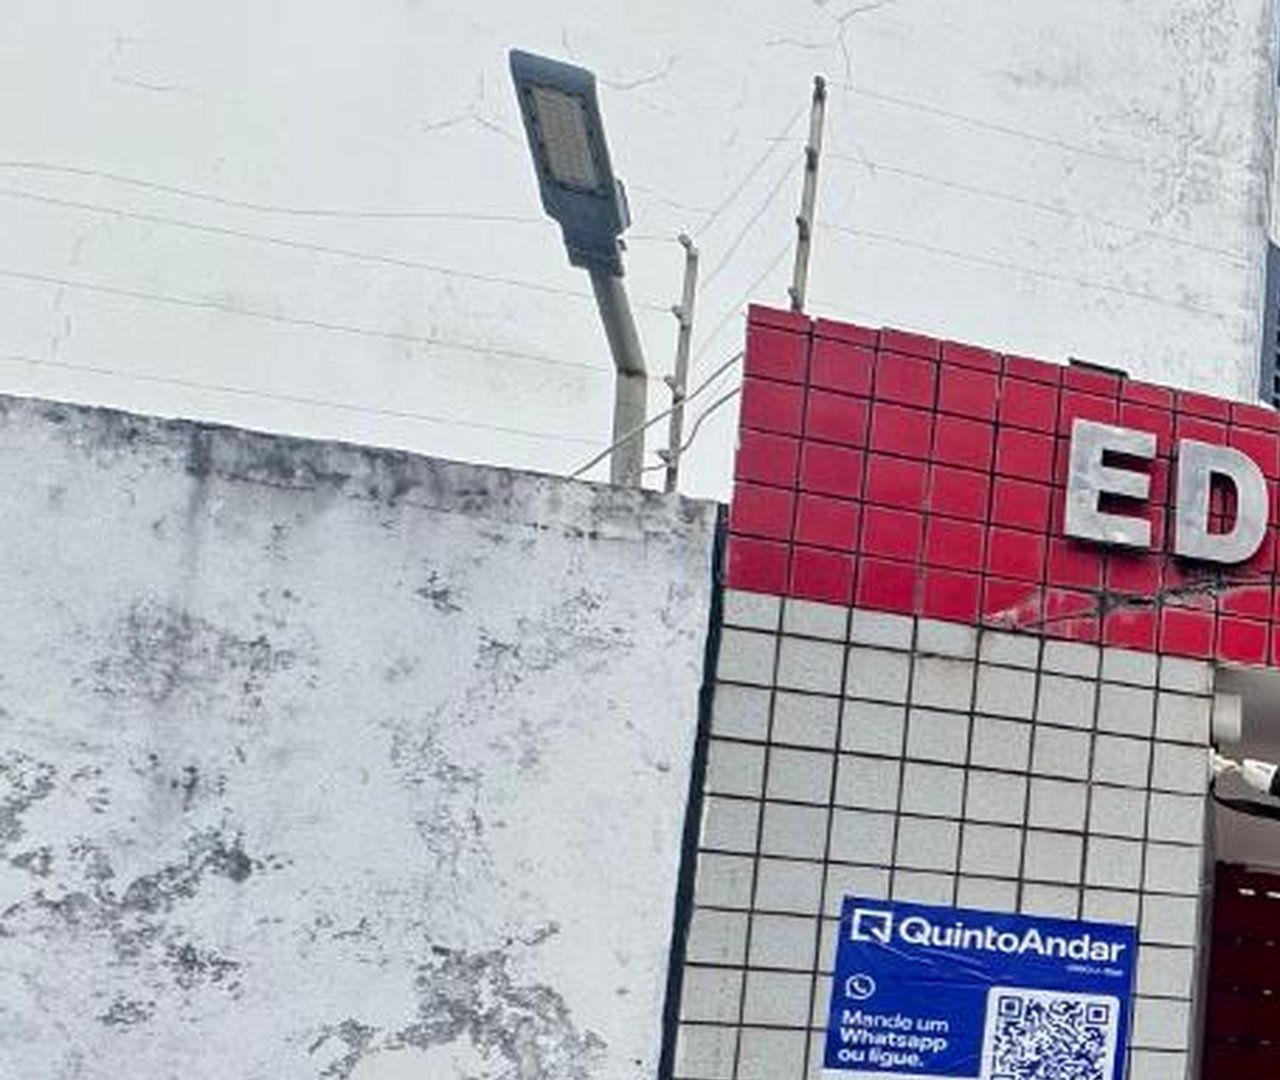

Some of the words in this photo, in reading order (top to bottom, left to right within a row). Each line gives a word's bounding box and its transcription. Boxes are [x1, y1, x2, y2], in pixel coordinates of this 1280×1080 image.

[900, 916, 1126, 963] QuintoAndar
[916, 1018, 949, 1033] um
[840, 1027, 948, 1054] Whatsapp
[838, 1048, 865, 1062] ou
